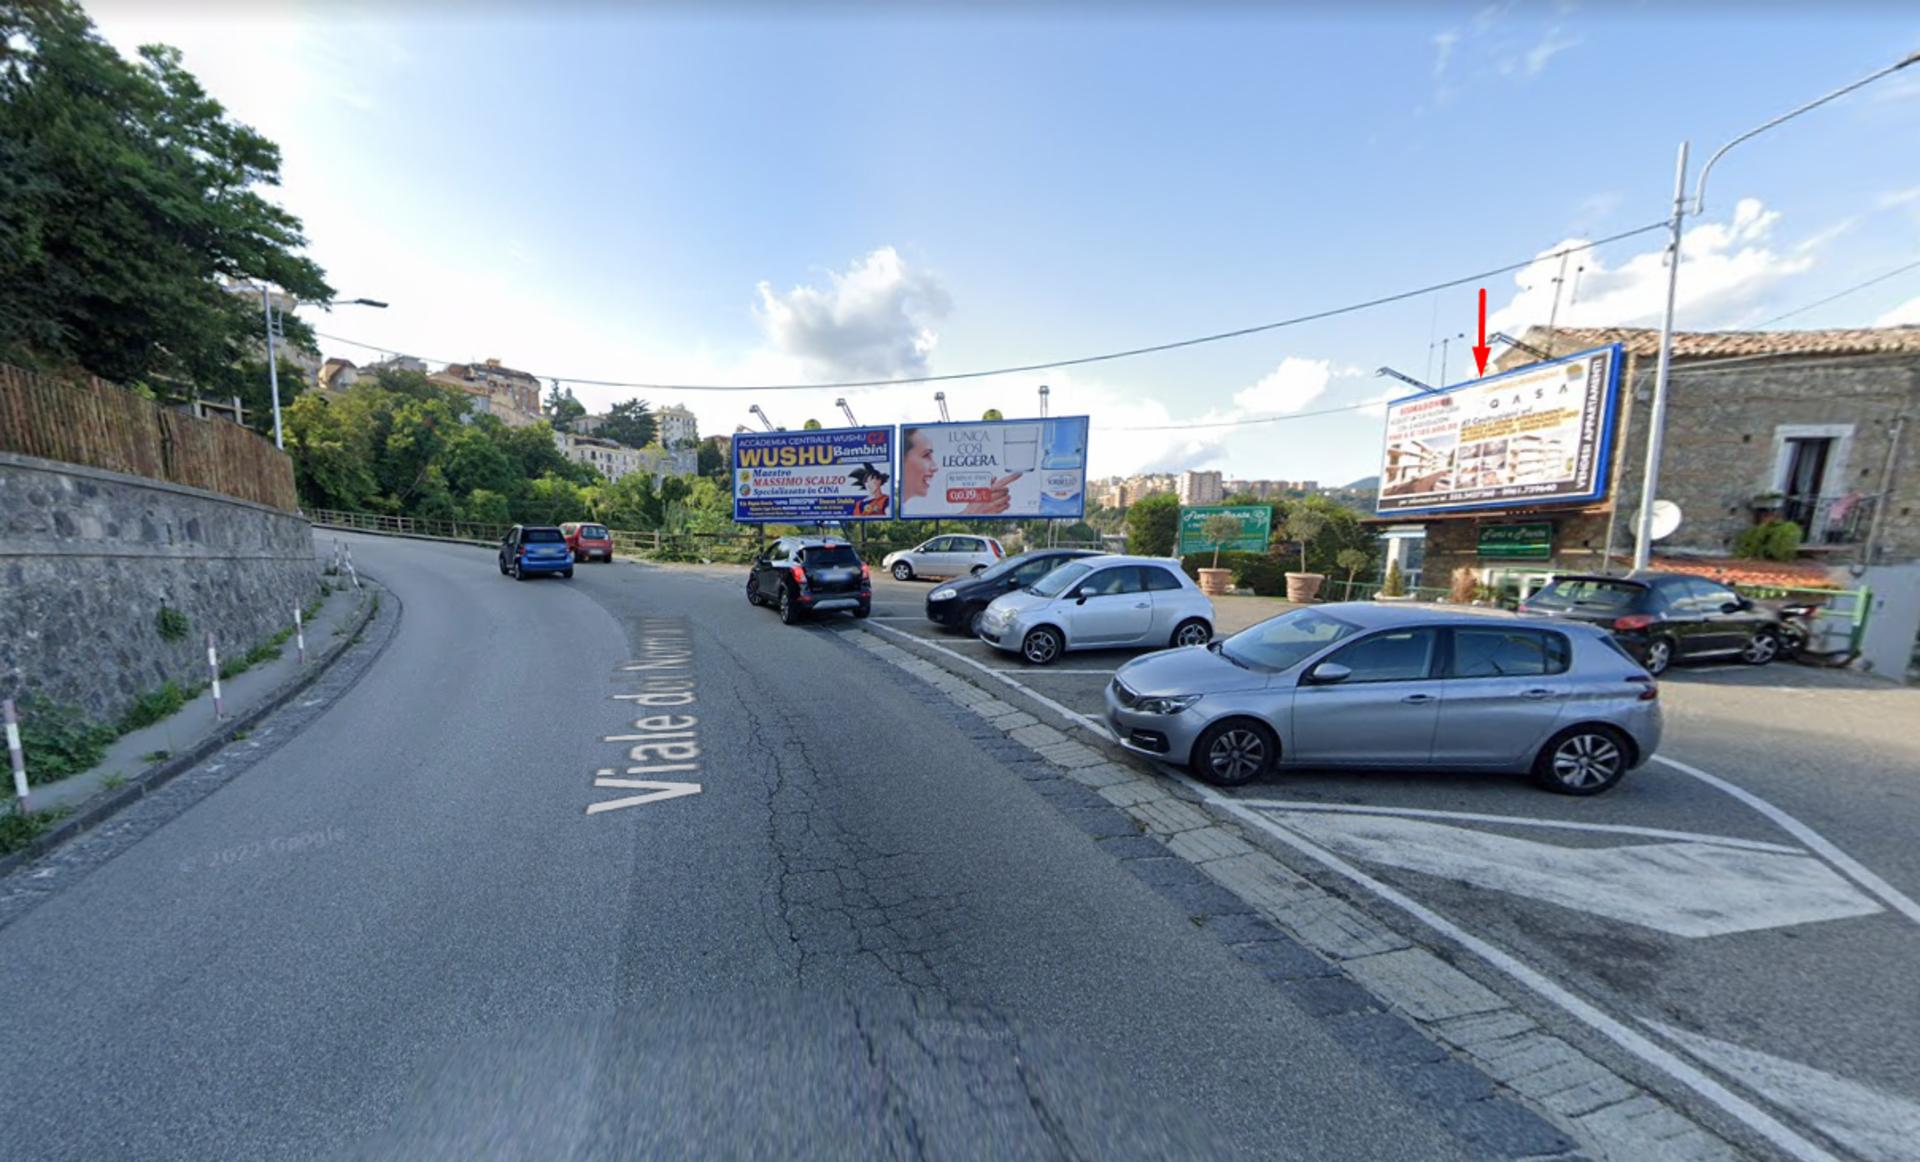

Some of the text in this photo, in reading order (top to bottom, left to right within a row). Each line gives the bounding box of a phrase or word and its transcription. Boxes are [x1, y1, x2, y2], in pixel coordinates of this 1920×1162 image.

[739, 437, 787, 447] ACCADEMIA
[788, 435, 832, 445] CENTRALE
[832, 433, 867, 443] WUSHU
[738, 445, 834, 468] WUSHU
[833, 443, 888, 457] Bambini
[943, 454, 1000, 468] LEGGERA
[752, 468, 792, 478] Maestro
[752, 475, 846, 488] MASSIMO SCALZO
[752, 485, 840, 498] Specializzato in CINA
